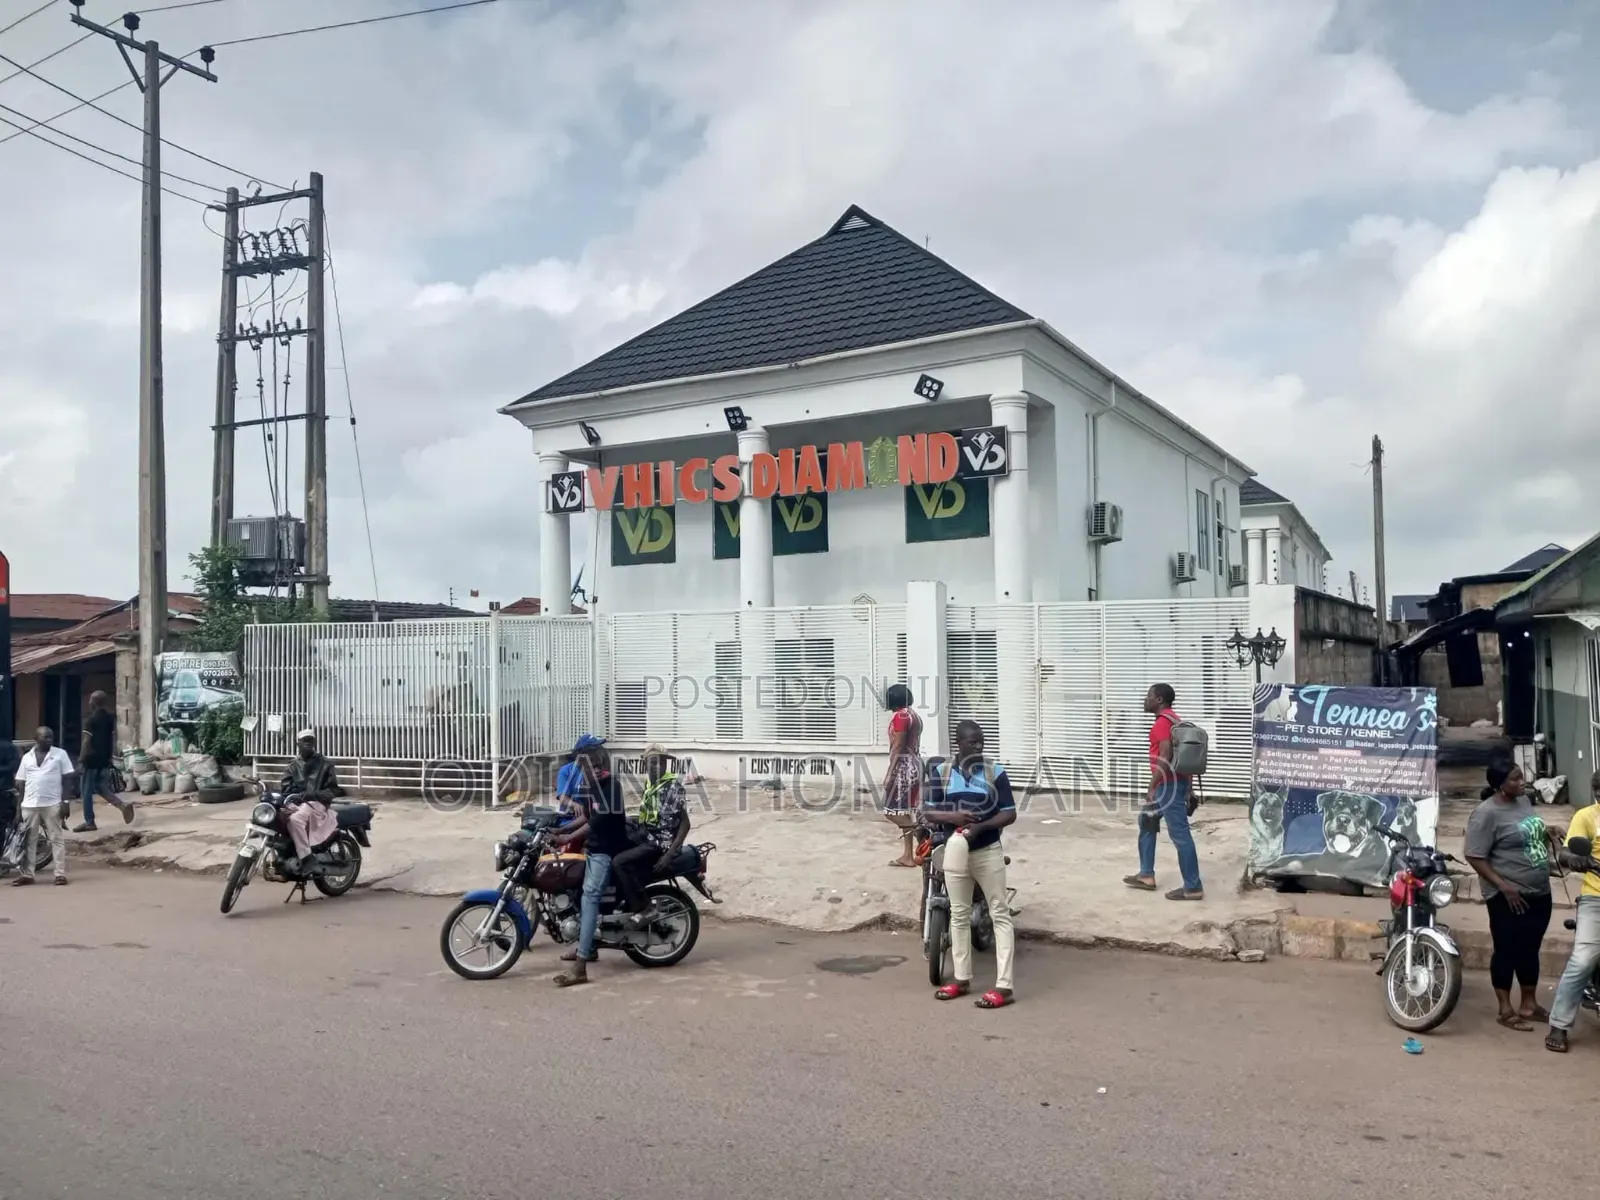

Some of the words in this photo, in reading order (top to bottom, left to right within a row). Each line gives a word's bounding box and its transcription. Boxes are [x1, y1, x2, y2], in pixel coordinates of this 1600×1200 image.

[587, 456, 743, 511] VHICS
[1284, 723, 1305, 733] PET
[1307, 725, 1343, 736] STORE
[1350, 728, 1394, 739] KENNEL
[1266, 750, 1291, 759] Selling
[1329, 755, 1342, 763] Pet
[1343, 757, 1367, 765] Foods
[671, 758, 692, 775] ONLY
[751, 757, 806, 775] CUSTOMERS
[810, 758, 836, 776] ONLY
[1378, 759, 1417, 768] Grooming
[1321, 772, 1338, 780] with
[1322, 763, 1341, 771] Farm
[1383, 767, 1427, 777] Fumigation
[1372, 786, 1390, 794] your
[1391, 786, 1420, 795] Female
